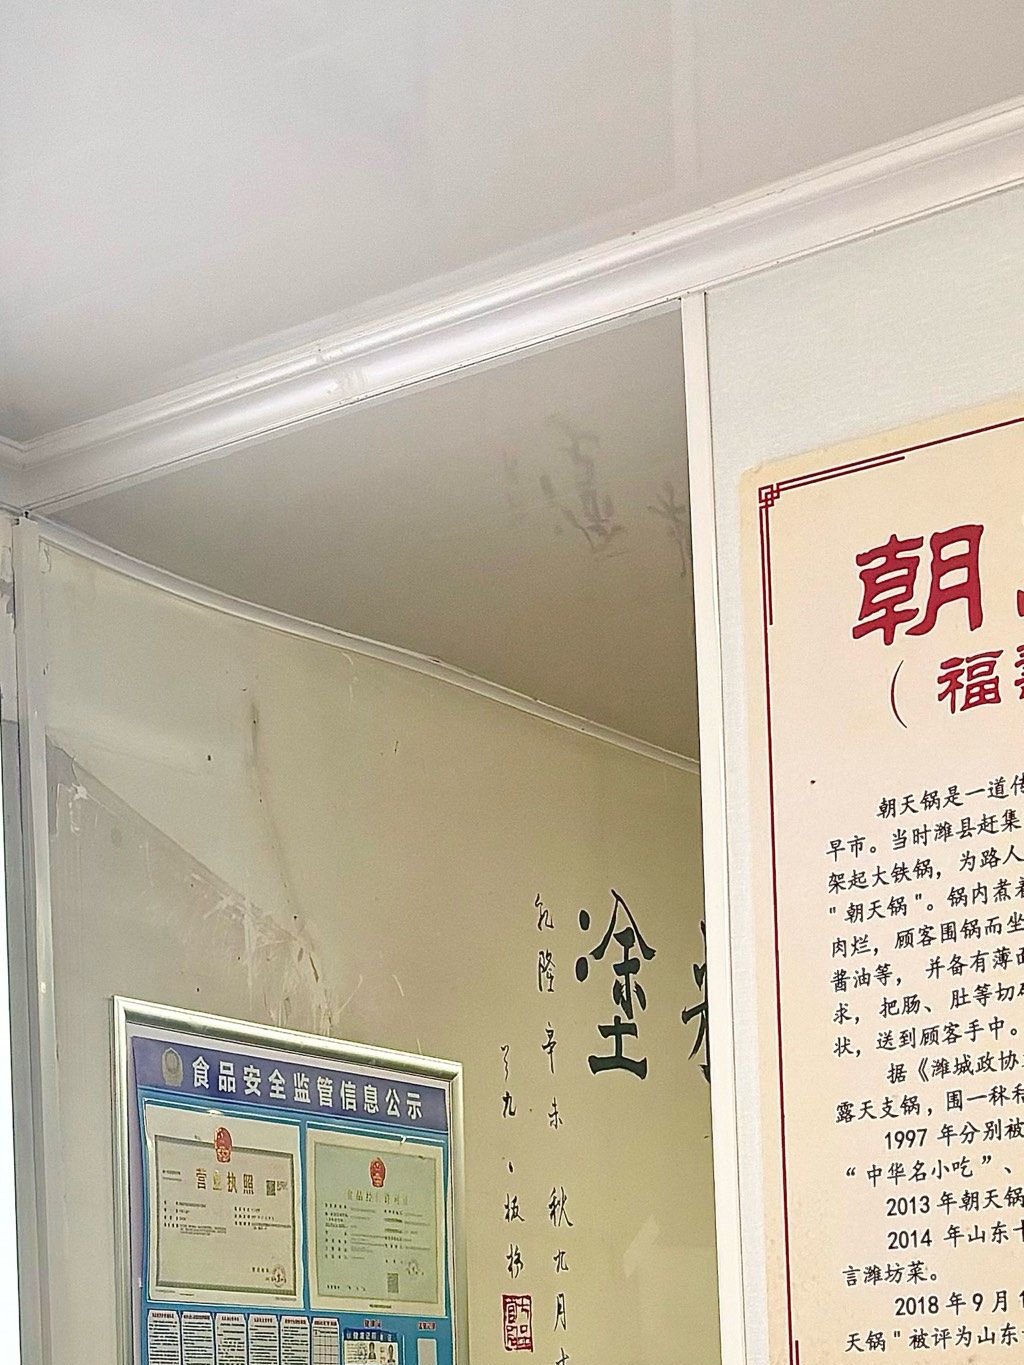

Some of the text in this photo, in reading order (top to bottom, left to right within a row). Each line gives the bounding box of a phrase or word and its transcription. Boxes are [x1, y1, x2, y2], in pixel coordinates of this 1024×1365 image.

[853, 524, 1024, 646] 朝
[192, 1055, 424, 1121] 食品安全监管信息公示
[887, 1050, 1024, 1084] 据《潍城政协
